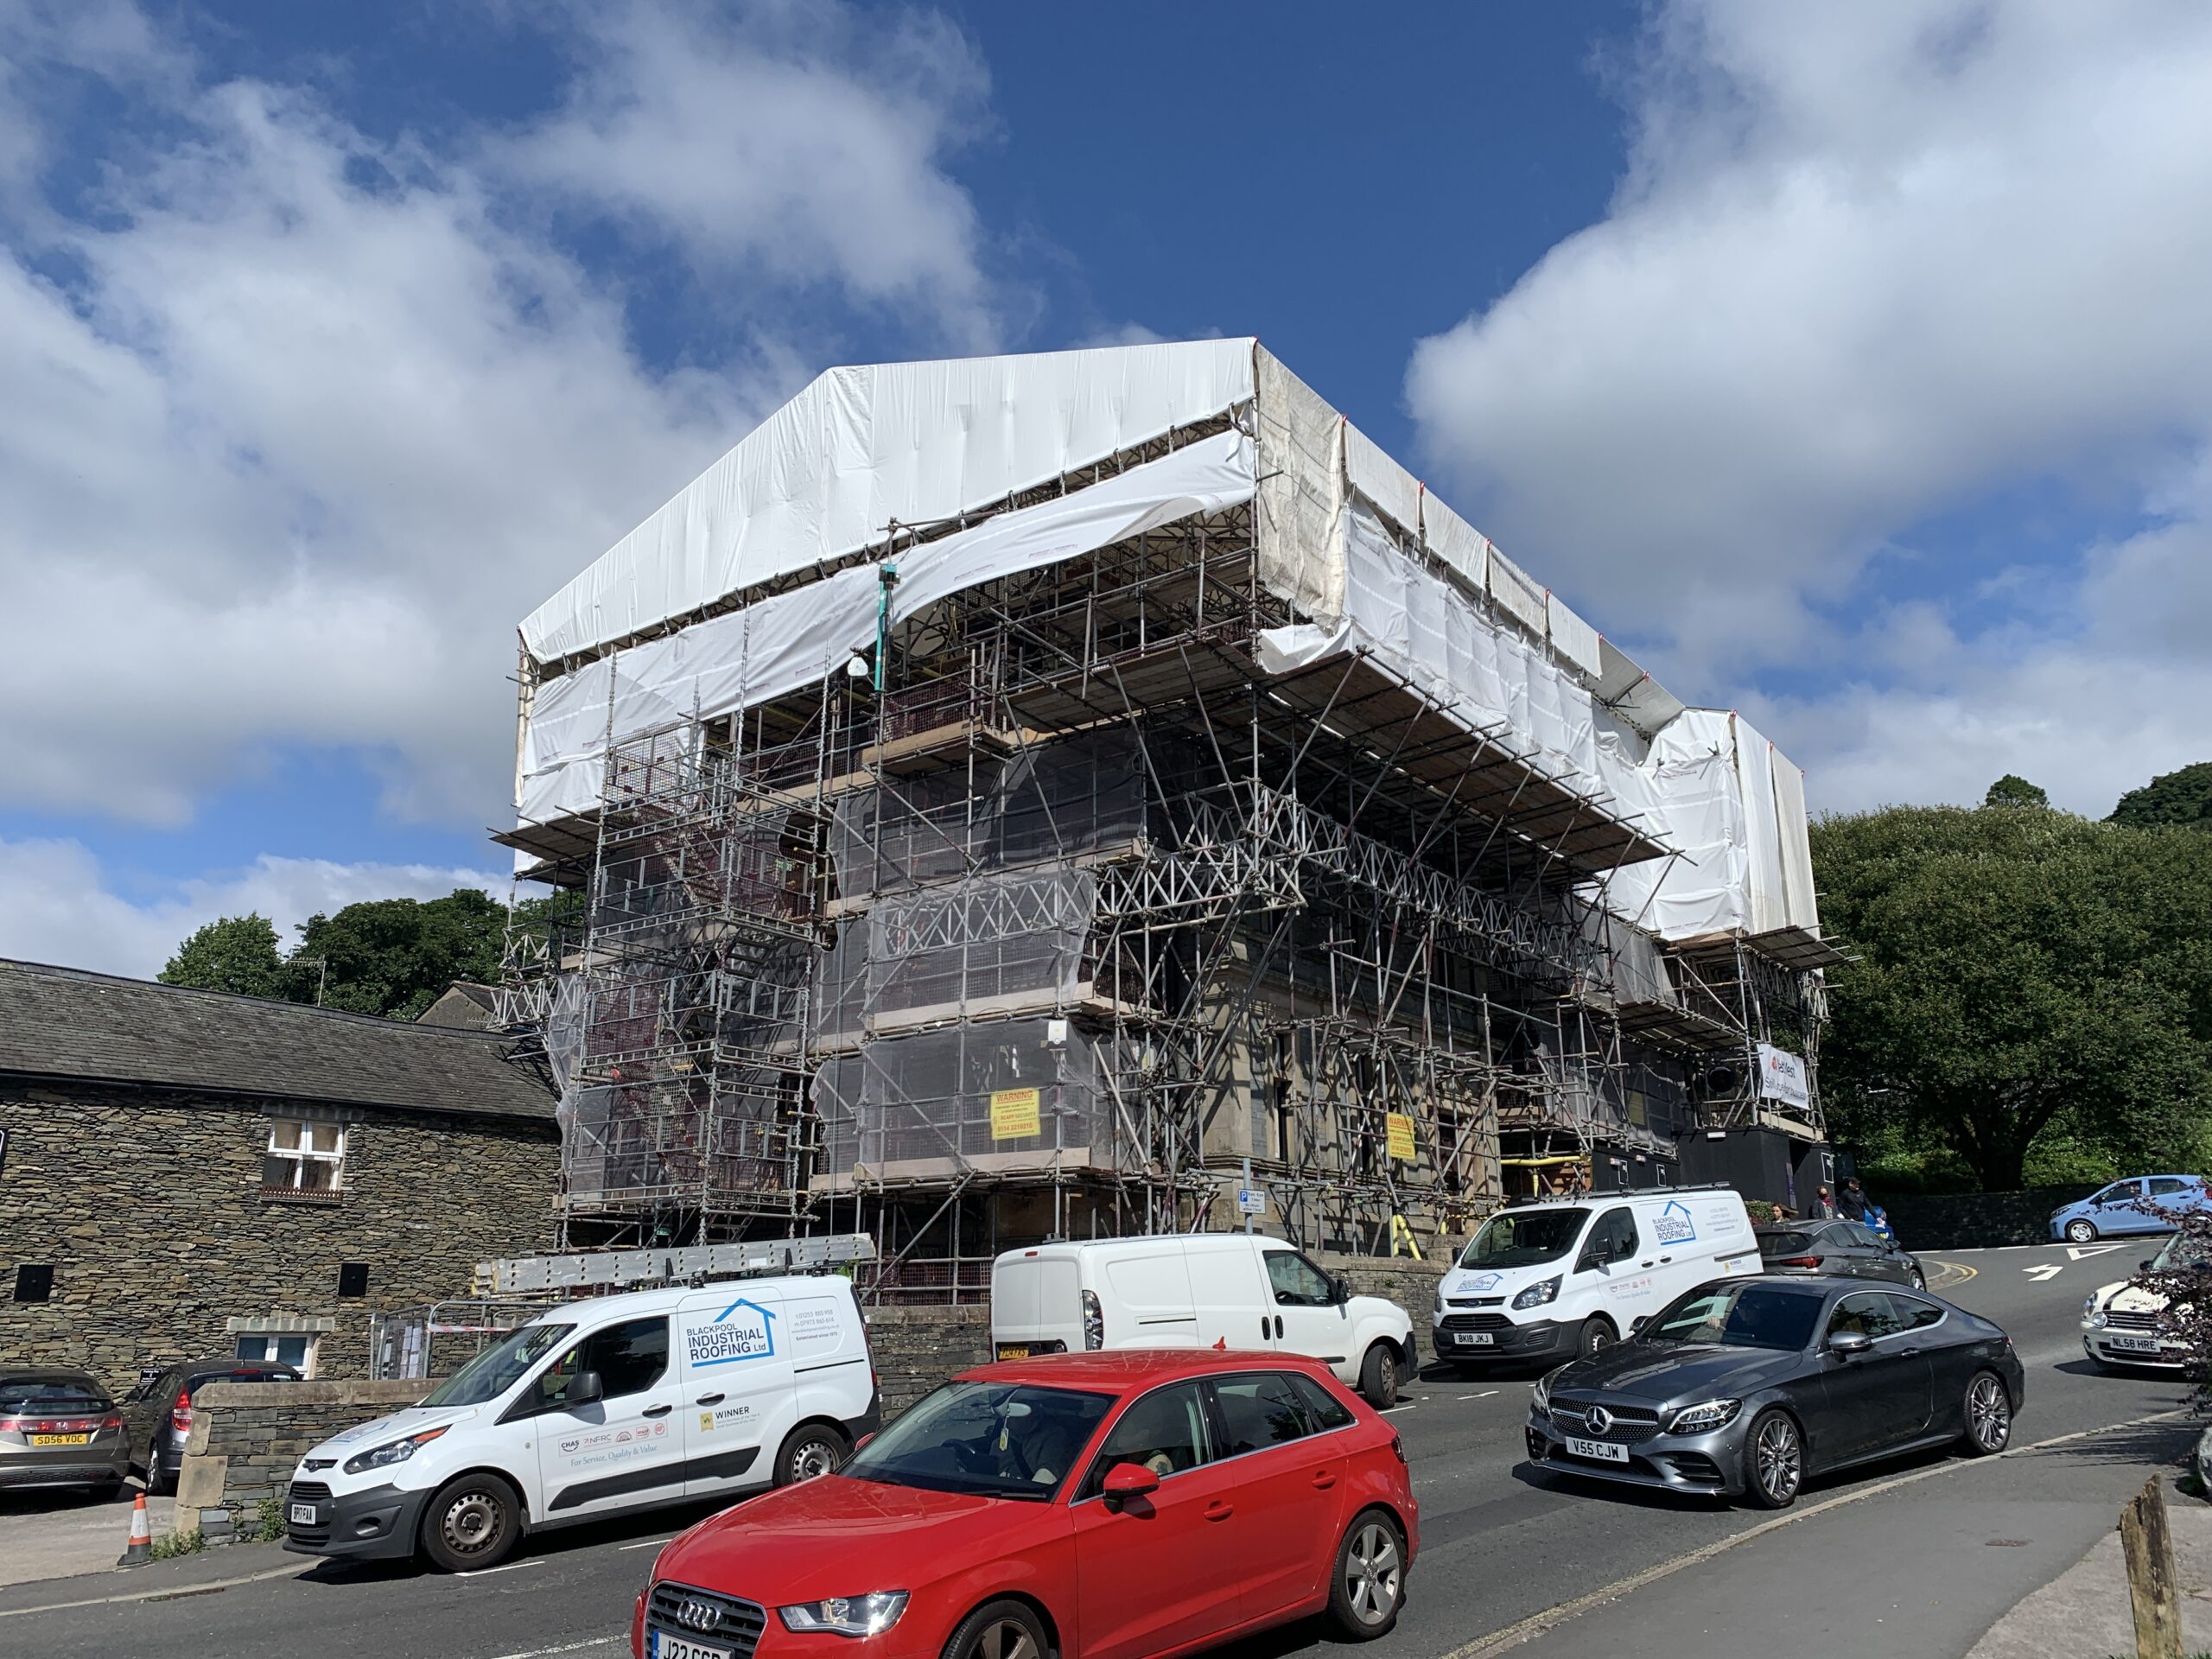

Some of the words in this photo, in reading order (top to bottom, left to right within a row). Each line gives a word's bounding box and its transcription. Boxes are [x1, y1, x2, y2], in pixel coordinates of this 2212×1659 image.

[996, 1090, 1033, 1103] WARNING
[1652, 1217, 1676, 1225] BLACKPOOL
[1655, 1220, 1690, 1233] INDUSTRIAL
[1657, 1229, 1686, 1242] ROOFING
[686, 1323, 738, 1337] BLACKPOOL
[688, 1328, 765, 1349] INDUSTRIAL
[1459, 1334, 1474, 1343] BK18
[1475, 1334, 1489, 1344] JKJ
[2113, 1338, 2136, 1349] NL58
[2137, 1339, 2157, 1351] HRE
[690, 1342, 751, 1361] ROOFING
[754, 1343, 766, 1352] Ltd
[715, 1406, 750, 1420] WINNER
[38, 1435, 62, 1445] SD56
[66, 1434, 83, 1443] VOC
[561, 1440, 580, 1448] CHAS
[589, 1434, 612, 1444] NFRC
[570, 1458, 582, 1467] For
[607, 1448, 632, 1461] Quality
[632, 1446, 639, 1455] &
[639, 1443, 658, 1453] Value
[1573, 1440, 1594, 1455] V55
[1596, 1444, 1619, 1459] CJW
